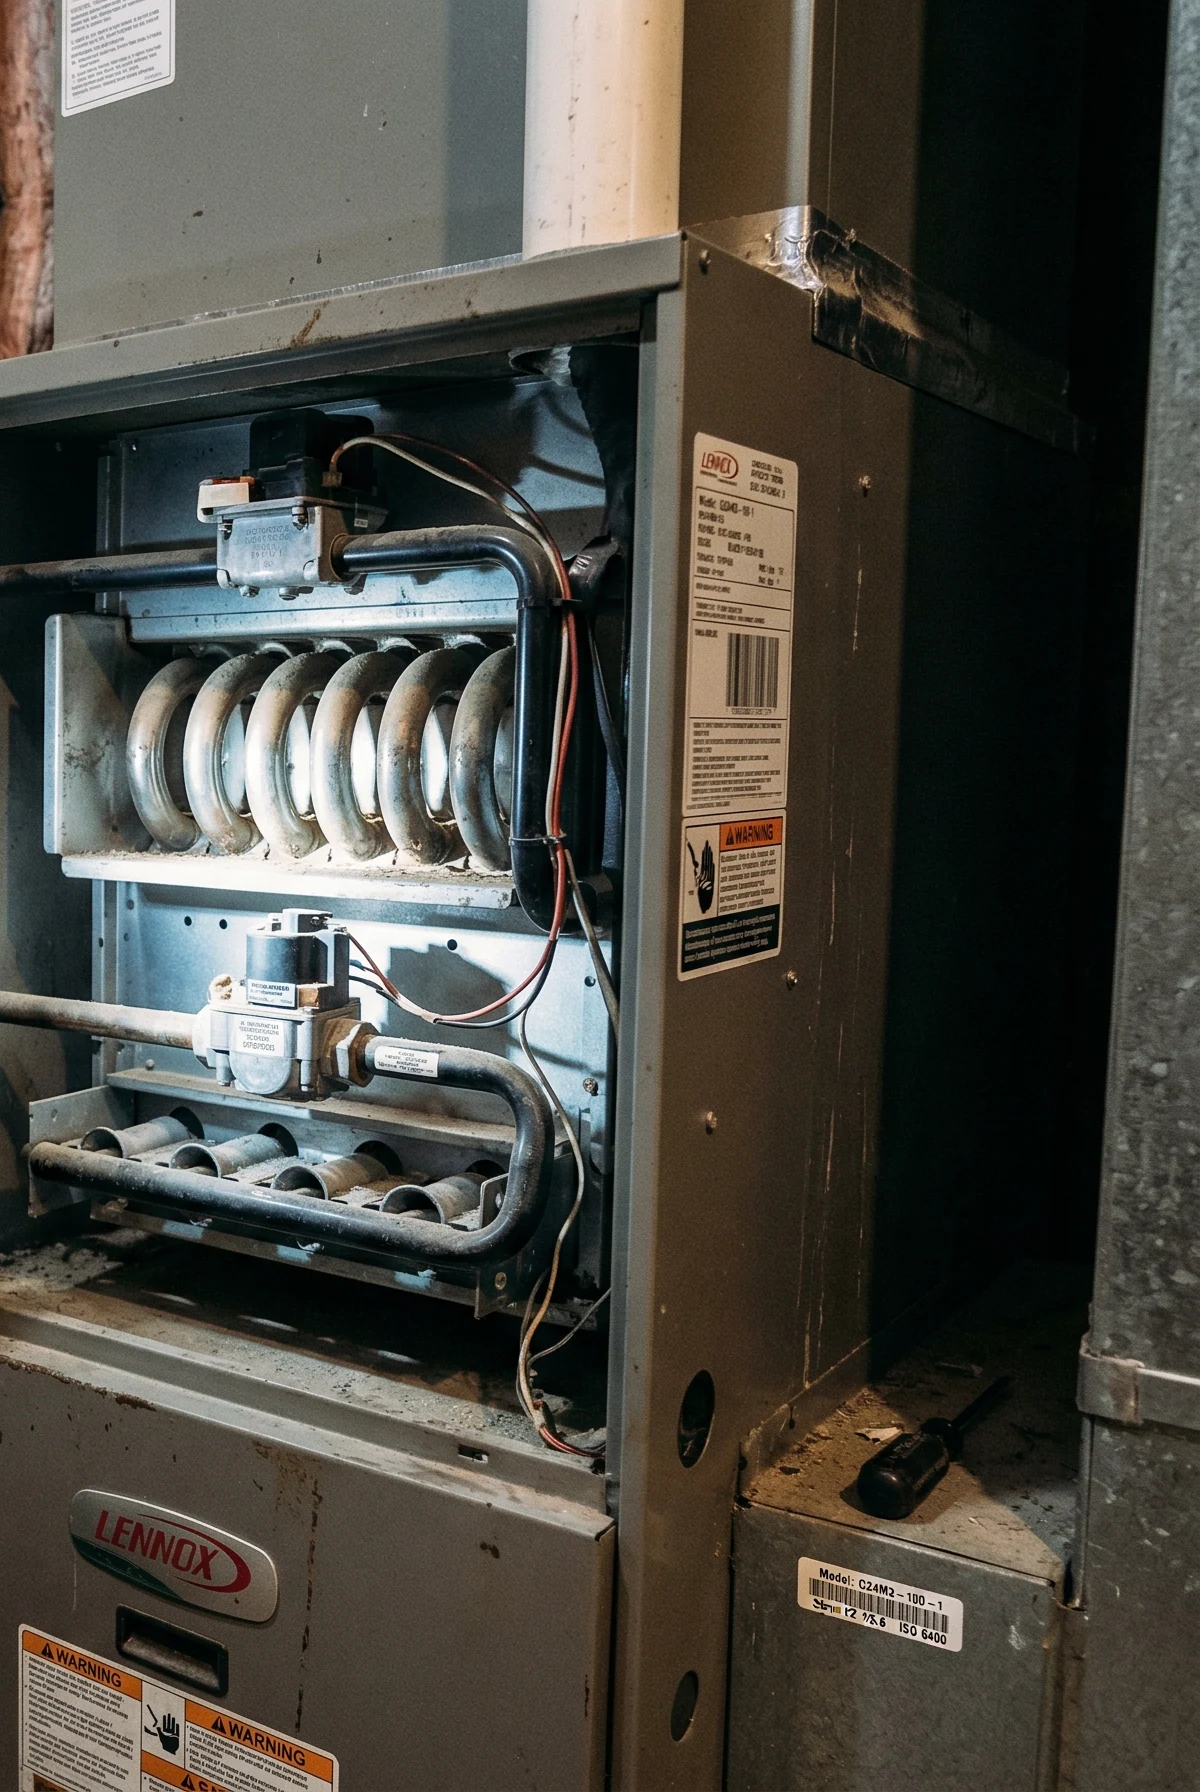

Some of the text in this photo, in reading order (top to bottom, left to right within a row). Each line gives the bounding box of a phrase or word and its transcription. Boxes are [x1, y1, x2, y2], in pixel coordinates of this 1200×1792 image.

[735, 824, 774, 844] WARNING
[94, 1509, 220, 1581] LENNOX
[819, 1568, 855, 1587] Model:
[899, 1622, 918, 1637] ISO
[922, 1630, 947, 1645] 6400
[56, 1648, 122, 1688] WARNING
[228, 1720, 306, 1767] WARNING
